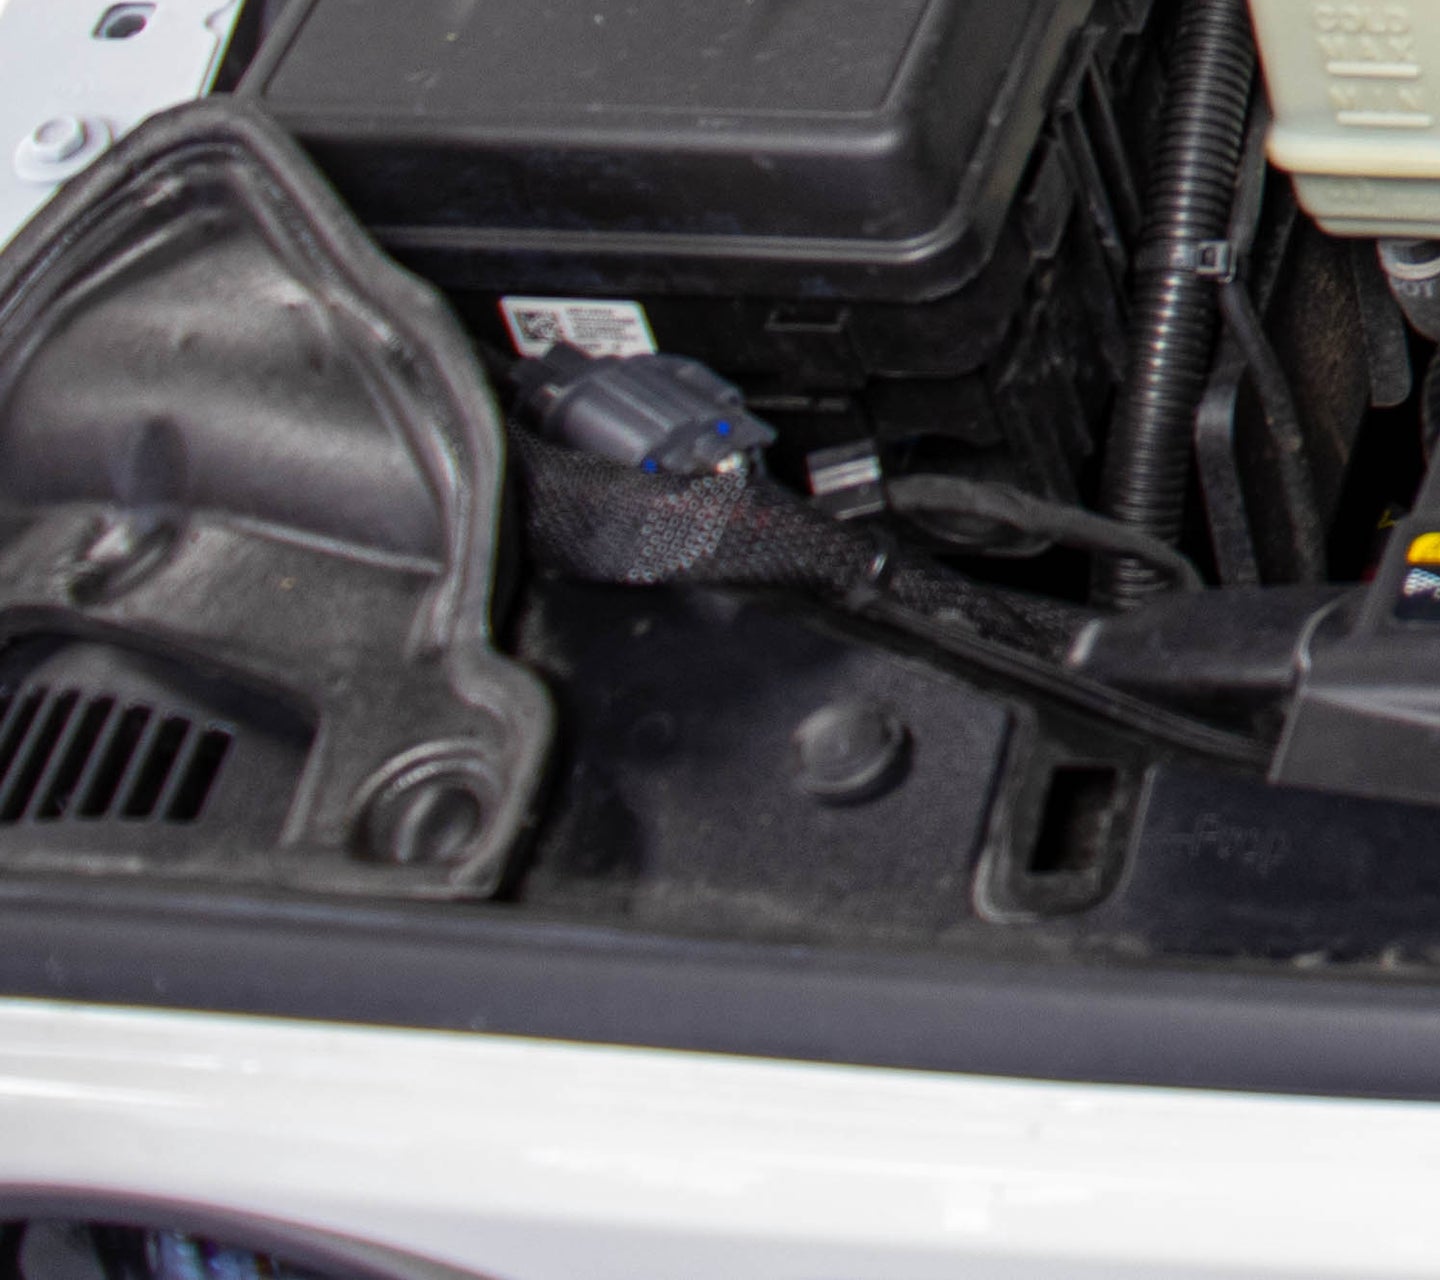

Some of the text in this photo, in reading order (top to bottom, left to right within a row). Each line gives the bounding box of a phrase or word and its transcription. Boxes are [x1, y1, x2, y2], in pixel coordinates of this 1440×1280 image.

[1313, 3, 1410, 33] COLD
[1316, 33, 1416, 61] MAX
[1328, 83, 1425, 111] MIN
